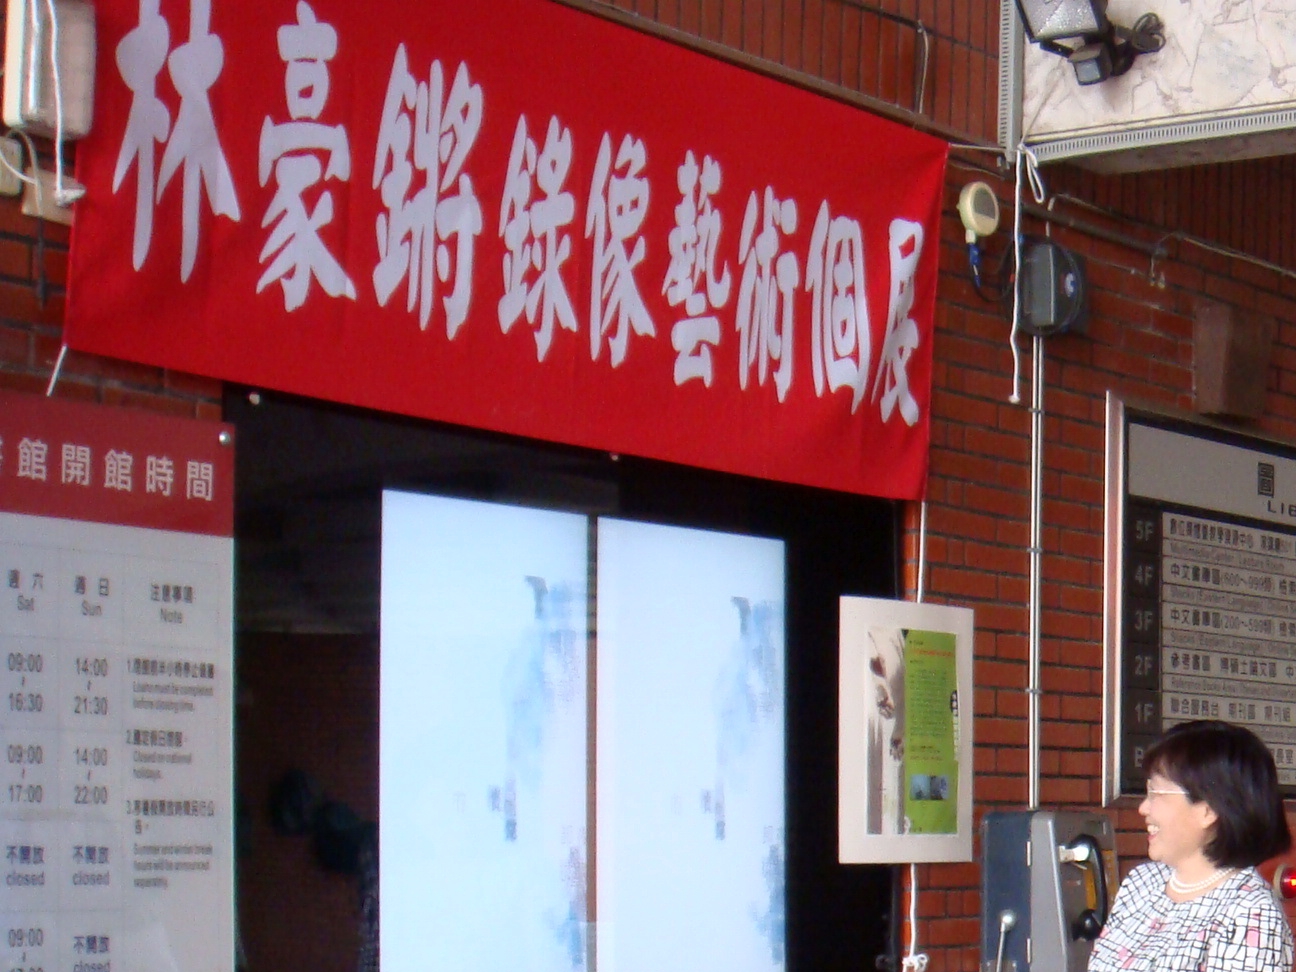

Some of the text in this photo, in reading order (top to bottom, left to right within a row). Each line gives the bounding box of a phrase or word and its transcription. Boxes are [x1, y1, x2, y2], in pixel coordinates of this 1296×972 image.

[0, 436, 214, 502] 館開館時間
[1134, 610, 1154, 632] 3F
[8, 653, 44, 672] 09:00
[74, 657, 109, 677] 14:00
[1134, 654, 1154, 676] 2F
[1134, 701, 1154, 723] 1F
[8, 745, 44, 765] 09:00
[74, 747, 108, 766] 14:00
[8, 784, 43, 803] 17:00
[73, 786, 108, 805] 22:00
[6, 870, 45, 887] closed
[72, 870, 110, 886] closed
[8, 928, 44, 947] 09:00
